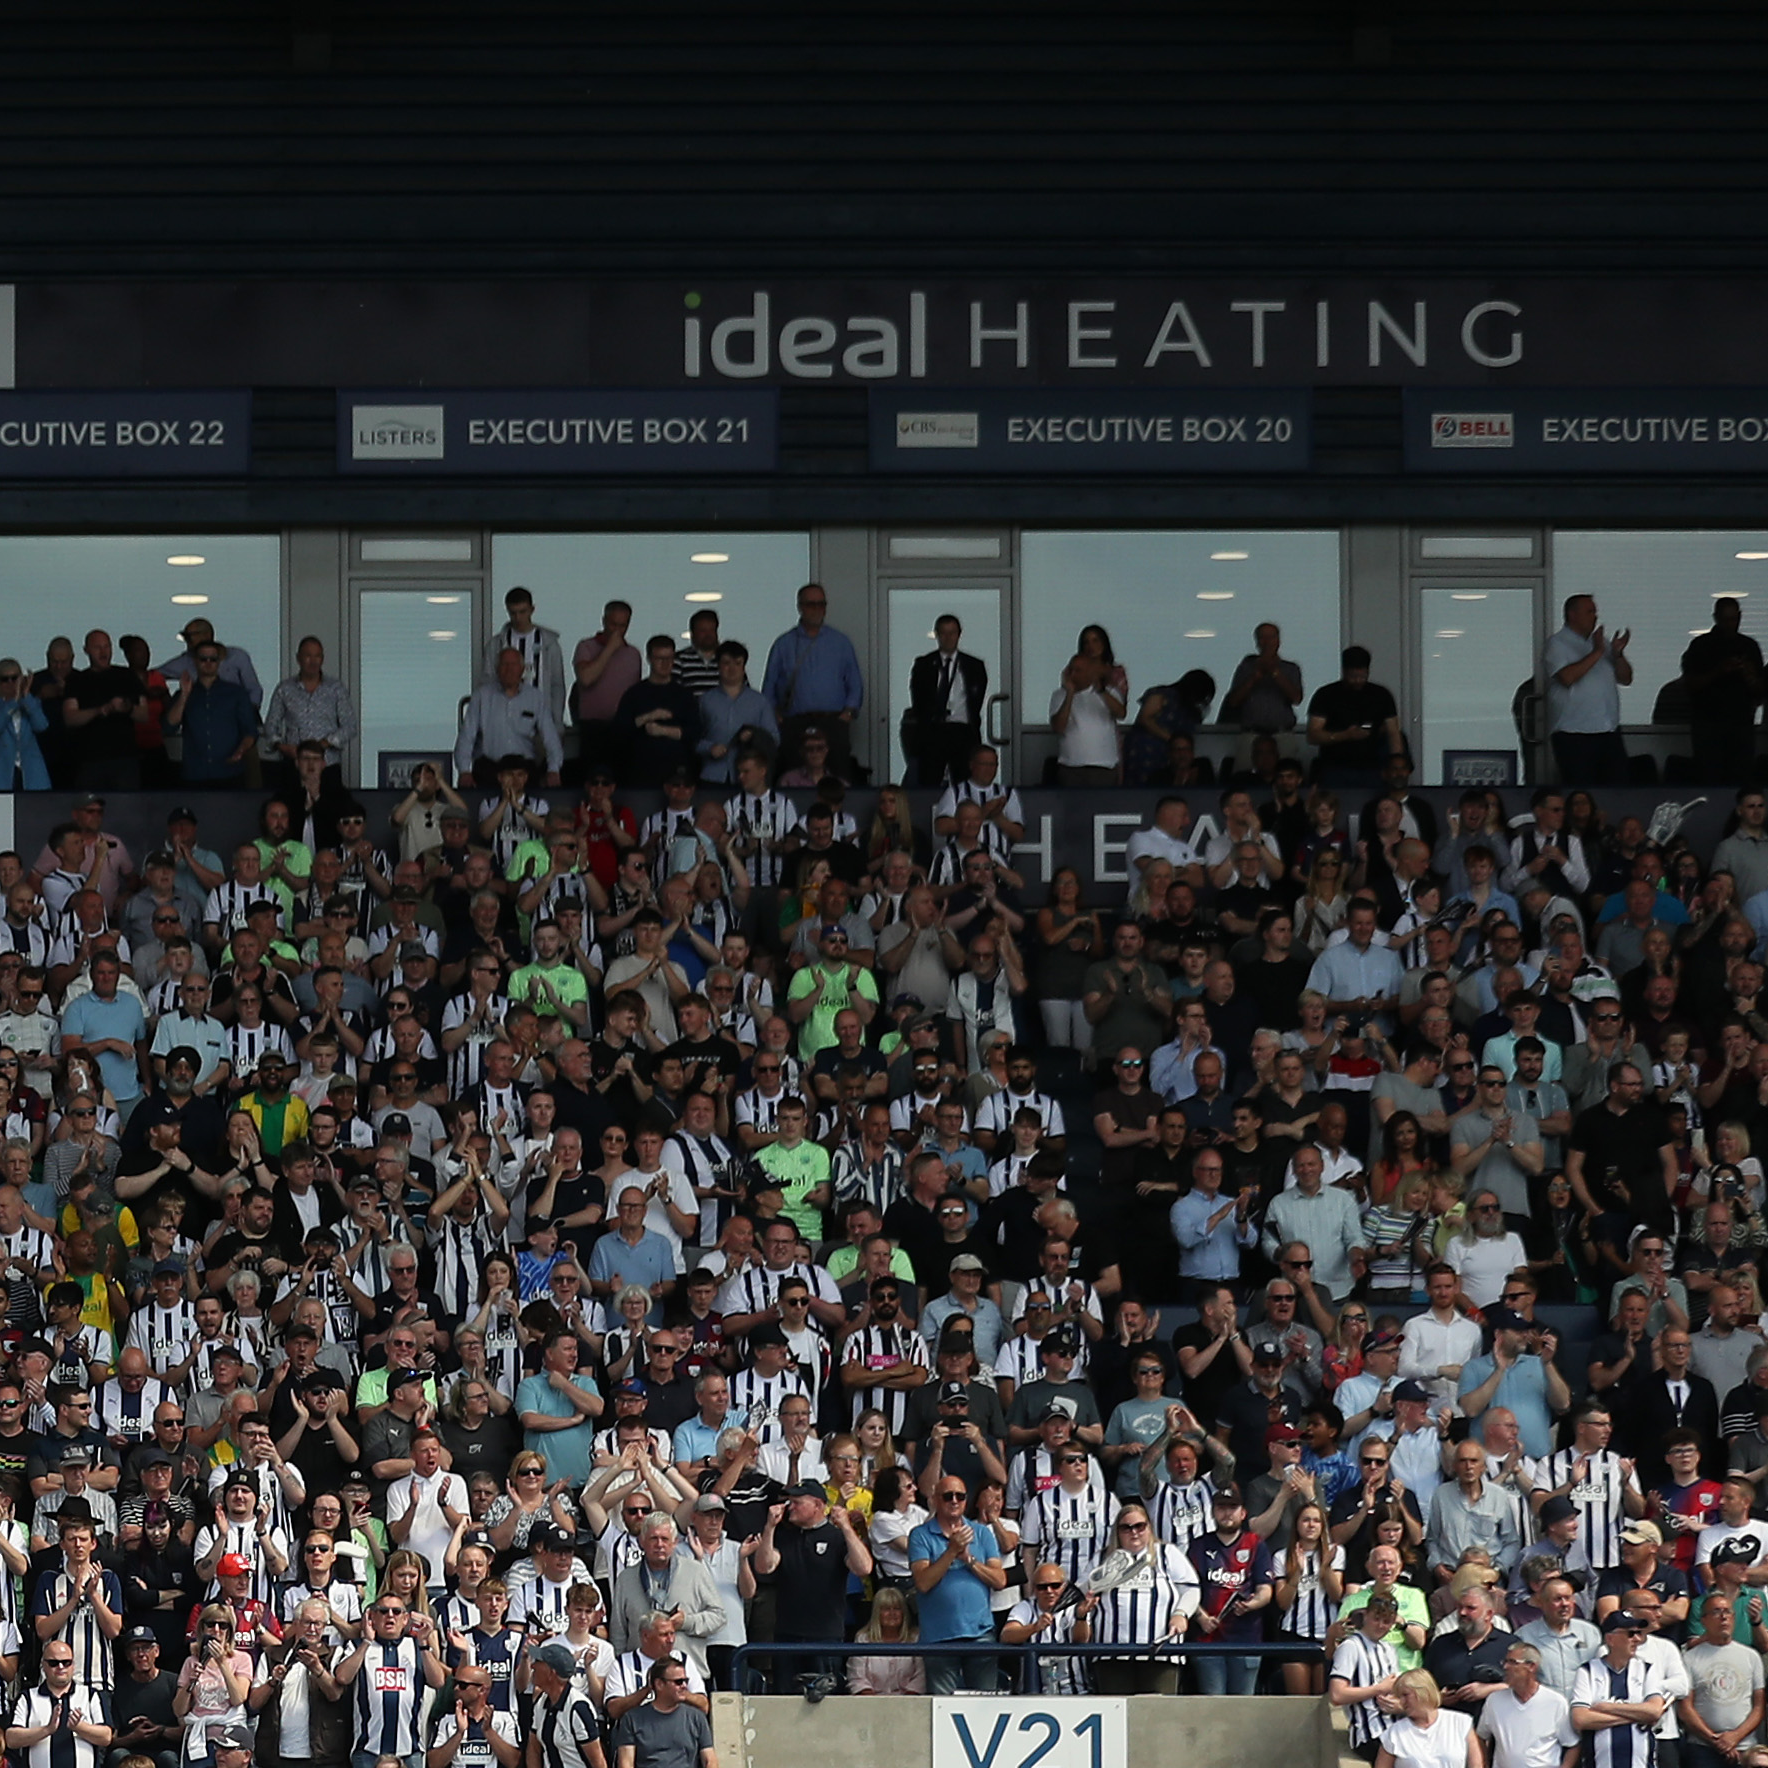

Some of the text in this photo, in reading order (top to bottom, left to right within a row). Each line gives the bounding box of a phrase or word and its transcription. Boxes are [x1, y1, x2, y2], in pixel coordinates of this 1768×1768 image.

[684, 291, 1521, 378] ideal HEATING
[117, 422, 179, 444] BOX
[190, 421, 223, 444] 22
[470, 419, 747, 443] EXECUTIVE BOX 21
[911, 420, 937, 435] CBS
[1008, 418, 1291, 441] EXECUTIVE BOX 20
[1459, 422, 1512, 437] BELL
[1544, 418, 1768, 441] EXECUTIVE BO
[360, 429, 437, 447] LISTERS
[1454, 768, 1502, 779] ALBION
[1572, 1484, 1603, 1494] ideal
[1057, 1520, 1093, 1531] ideal
[1208, 1569, 1245, 1582] ideal
[479, 1659, 511, 1672] ideal
[376, 1668, 406, 1688] BSR
[462, 1744, 491, 1755] ideal
